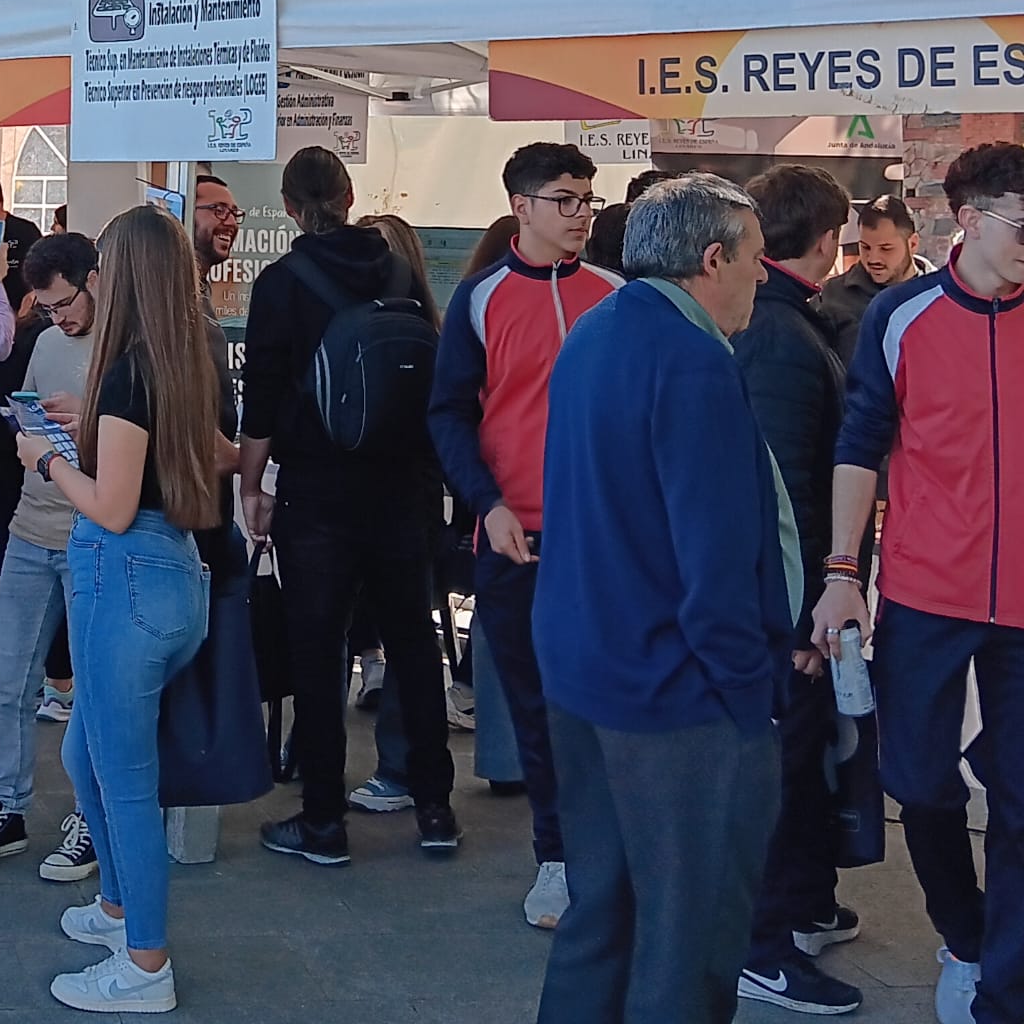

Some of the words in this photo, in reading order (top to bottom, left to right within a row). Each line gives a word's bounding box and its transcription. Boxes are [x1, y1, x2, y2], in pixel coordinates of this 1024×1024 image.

[243, 39, 250, 63] de
[638, 55, 729, 95] I.E.S.
[743, 49, 882, 92] REYES
[897, 46, 956, 88] DE
[973, 42, 1024, 87] ES
[174, 77, 182, 99] de
[579, 133, 612, 147] I.E.S.
[617, 132, 650, 146] REYE
[622, 149, 652, 160] LIN
[249, 206, 261, 217] de
[206, 258, 273, 284] OFESI
[237, 290, 250, 301] Ins
